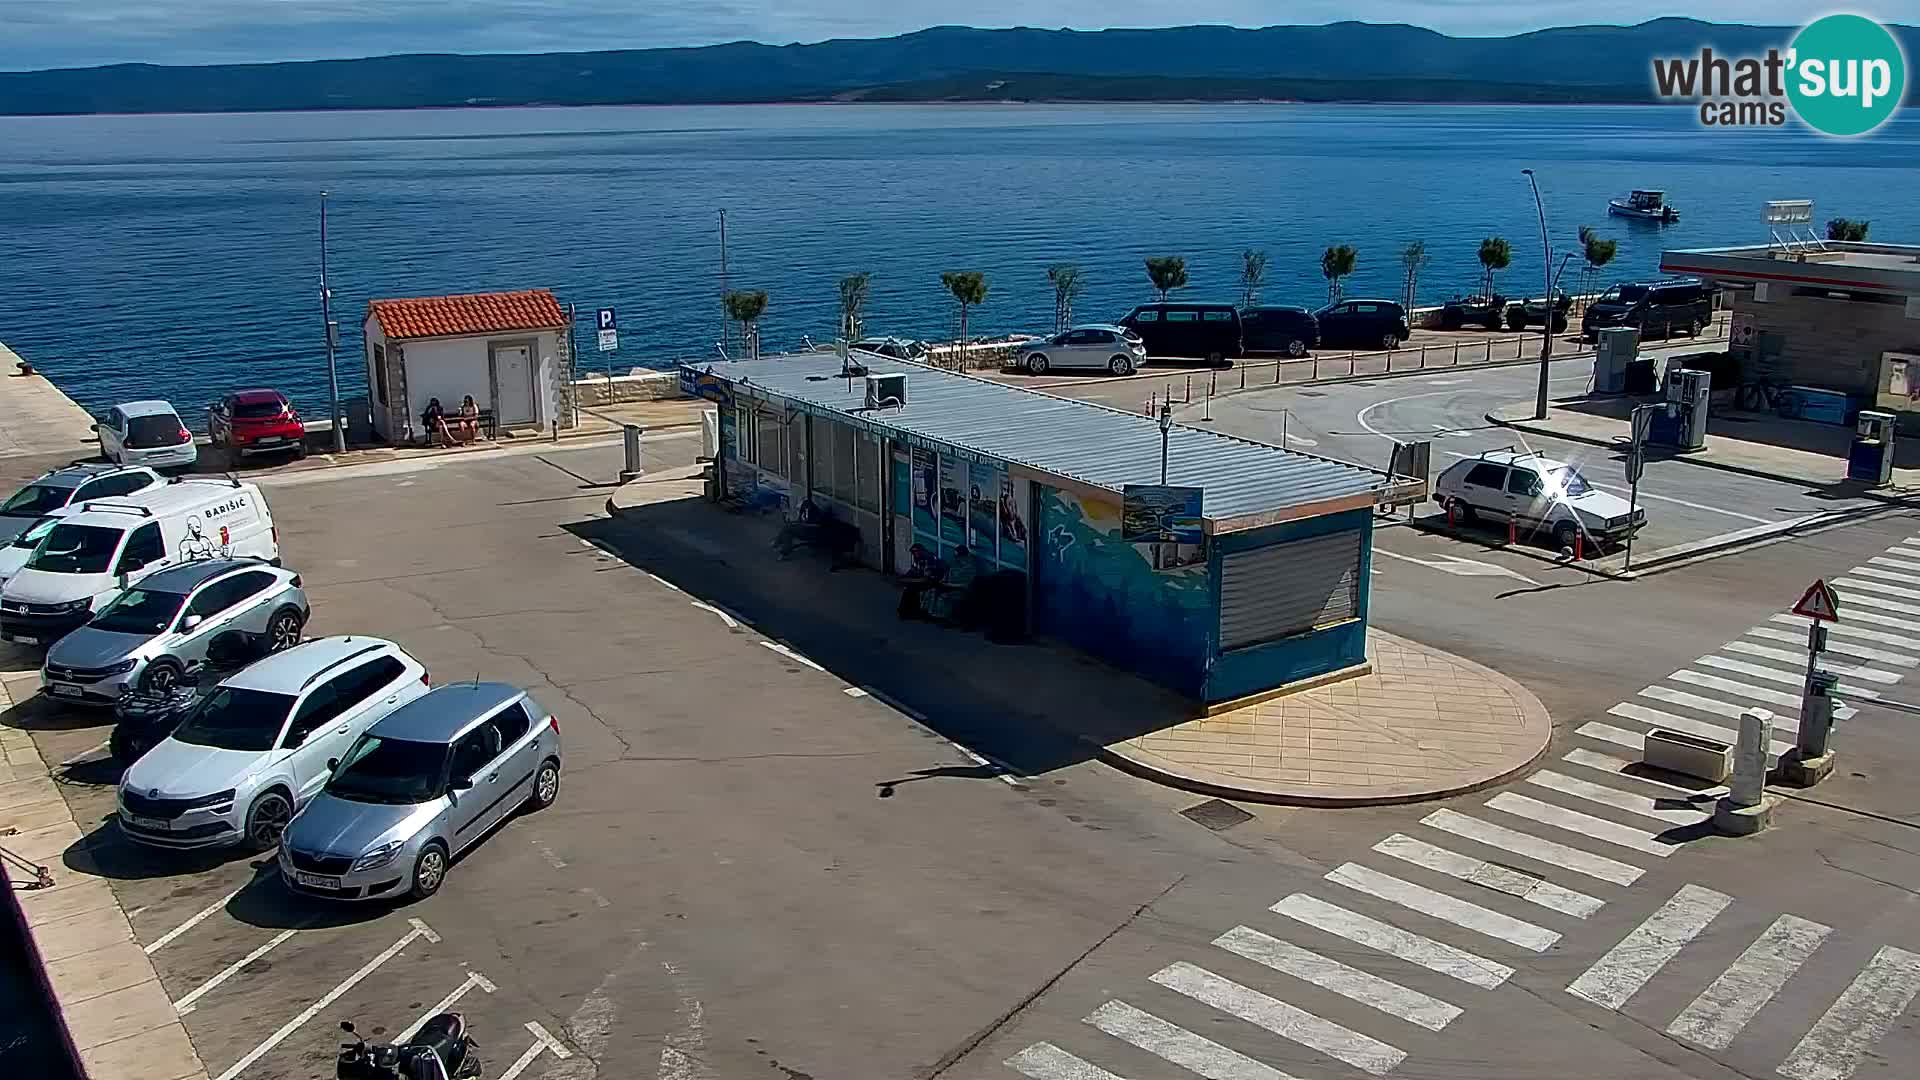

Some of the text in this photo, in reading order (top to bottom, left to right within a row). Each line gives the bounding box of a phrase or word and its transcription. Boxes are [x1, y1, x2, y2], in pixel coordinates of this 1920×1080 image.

[601, 311, 612, 328] P
[907, 435, 921, 446] BUS
[922, 440, 952, 455] STATION
[955, 448, 978, 462] TICKET
